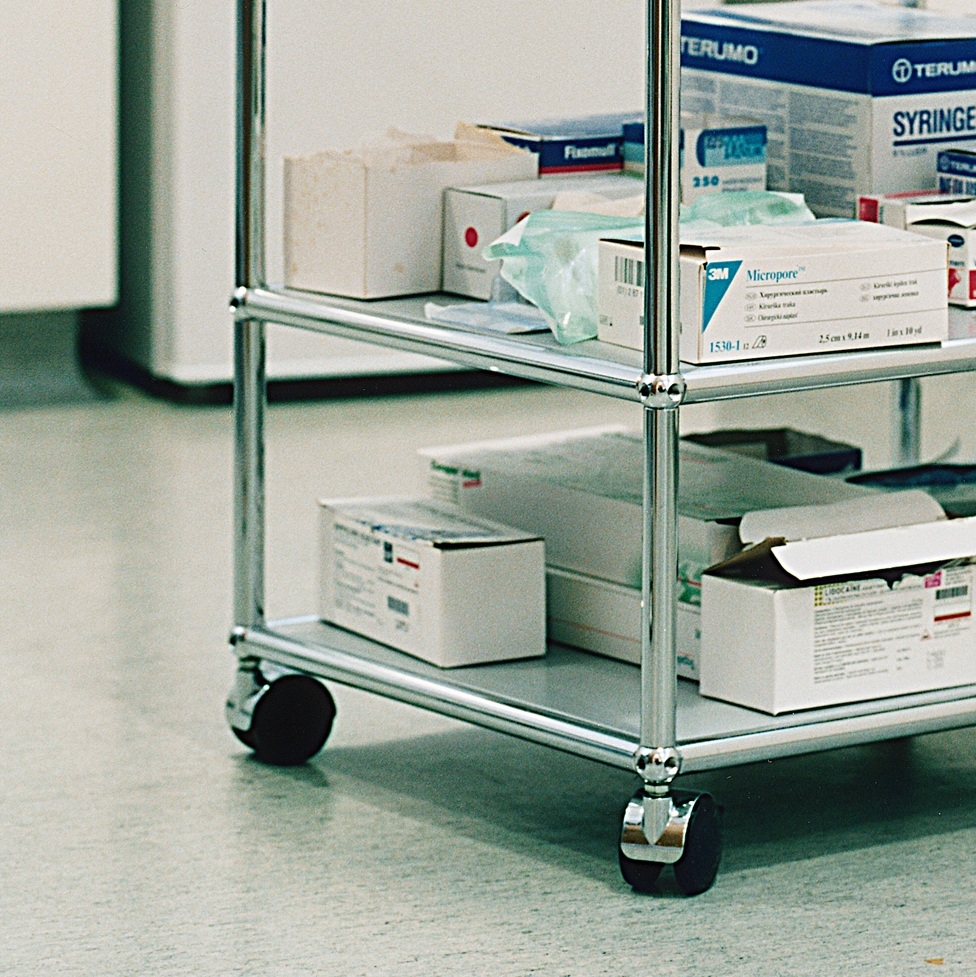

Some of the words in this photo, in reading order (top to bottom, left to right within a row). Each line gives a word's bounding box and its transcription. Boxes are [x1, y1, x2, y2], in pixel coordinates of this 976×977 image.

[893, 106, 976, 136] SYRINGE
[708, 268, 729, 281] 3M
[709, 340, 740, 353] 1530-1
